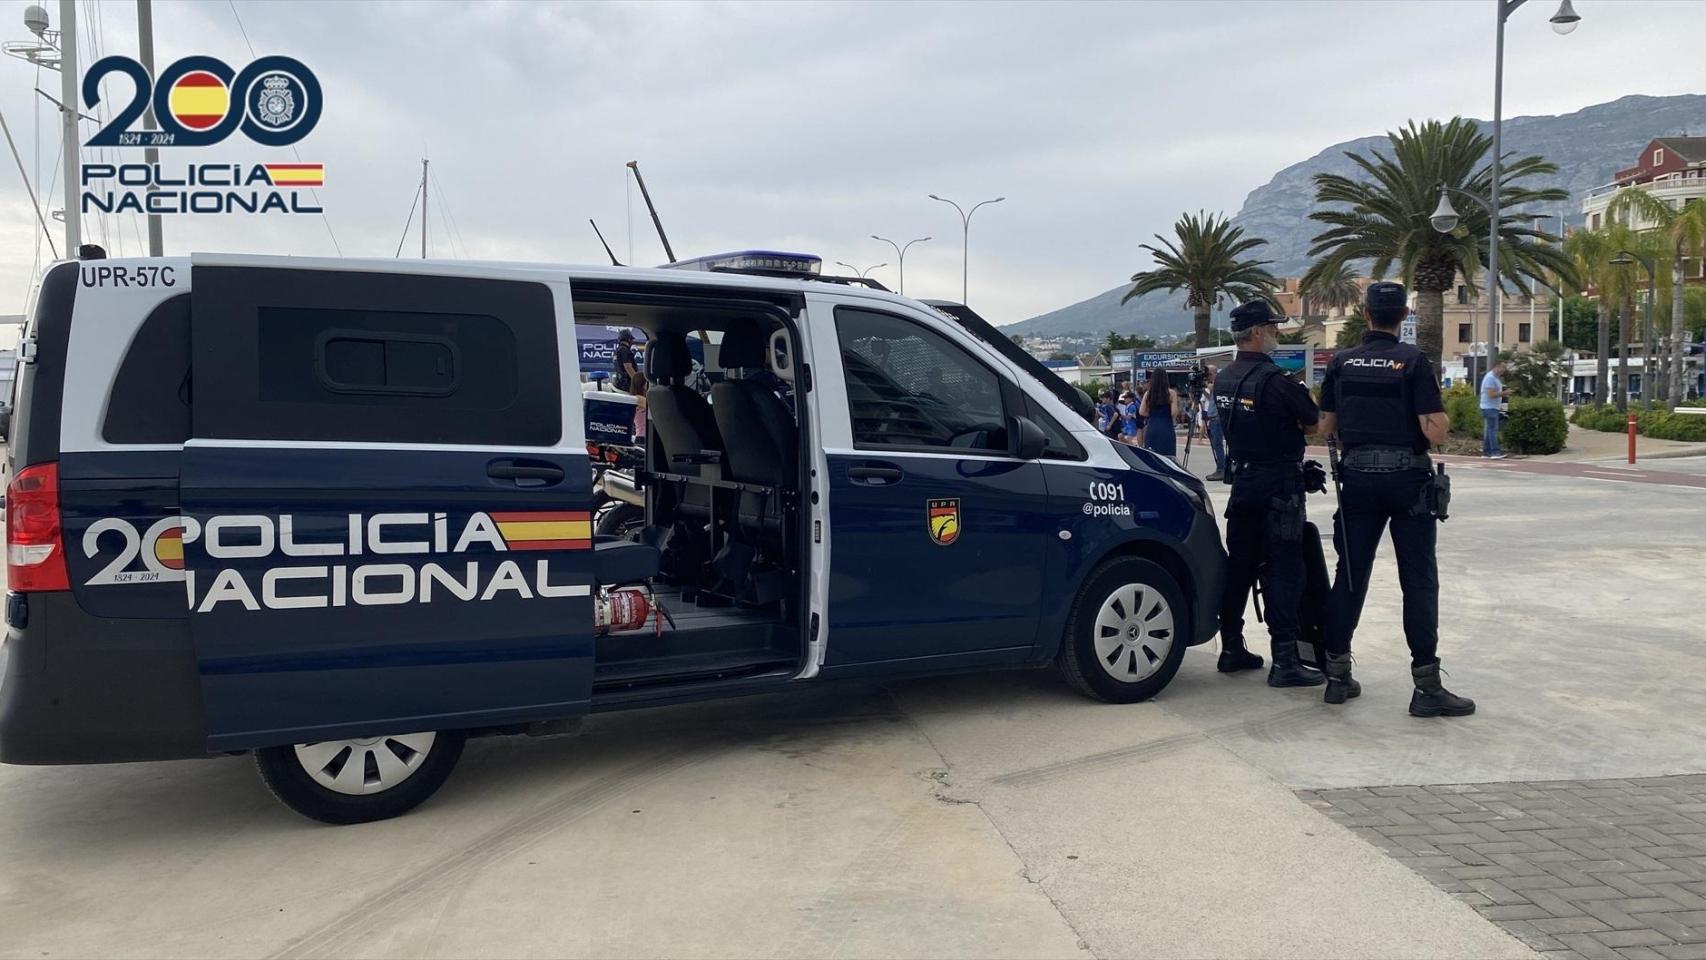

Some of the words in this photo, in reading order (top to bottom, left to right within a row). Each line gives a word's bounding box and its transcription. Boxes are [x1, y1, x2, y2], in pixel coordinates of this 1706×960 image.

[82, 266, 176, 288] UPR-57C
[1403, 327, 1413, 337] 24
[1344, 358, 1396, 368] POLICIA
[1099, 483, 1125, 501] 091
[1082, 502, 1131, 517] @policia
[114, 574, 132, 582] 1824
[140, 572, 159, 581] 2024
